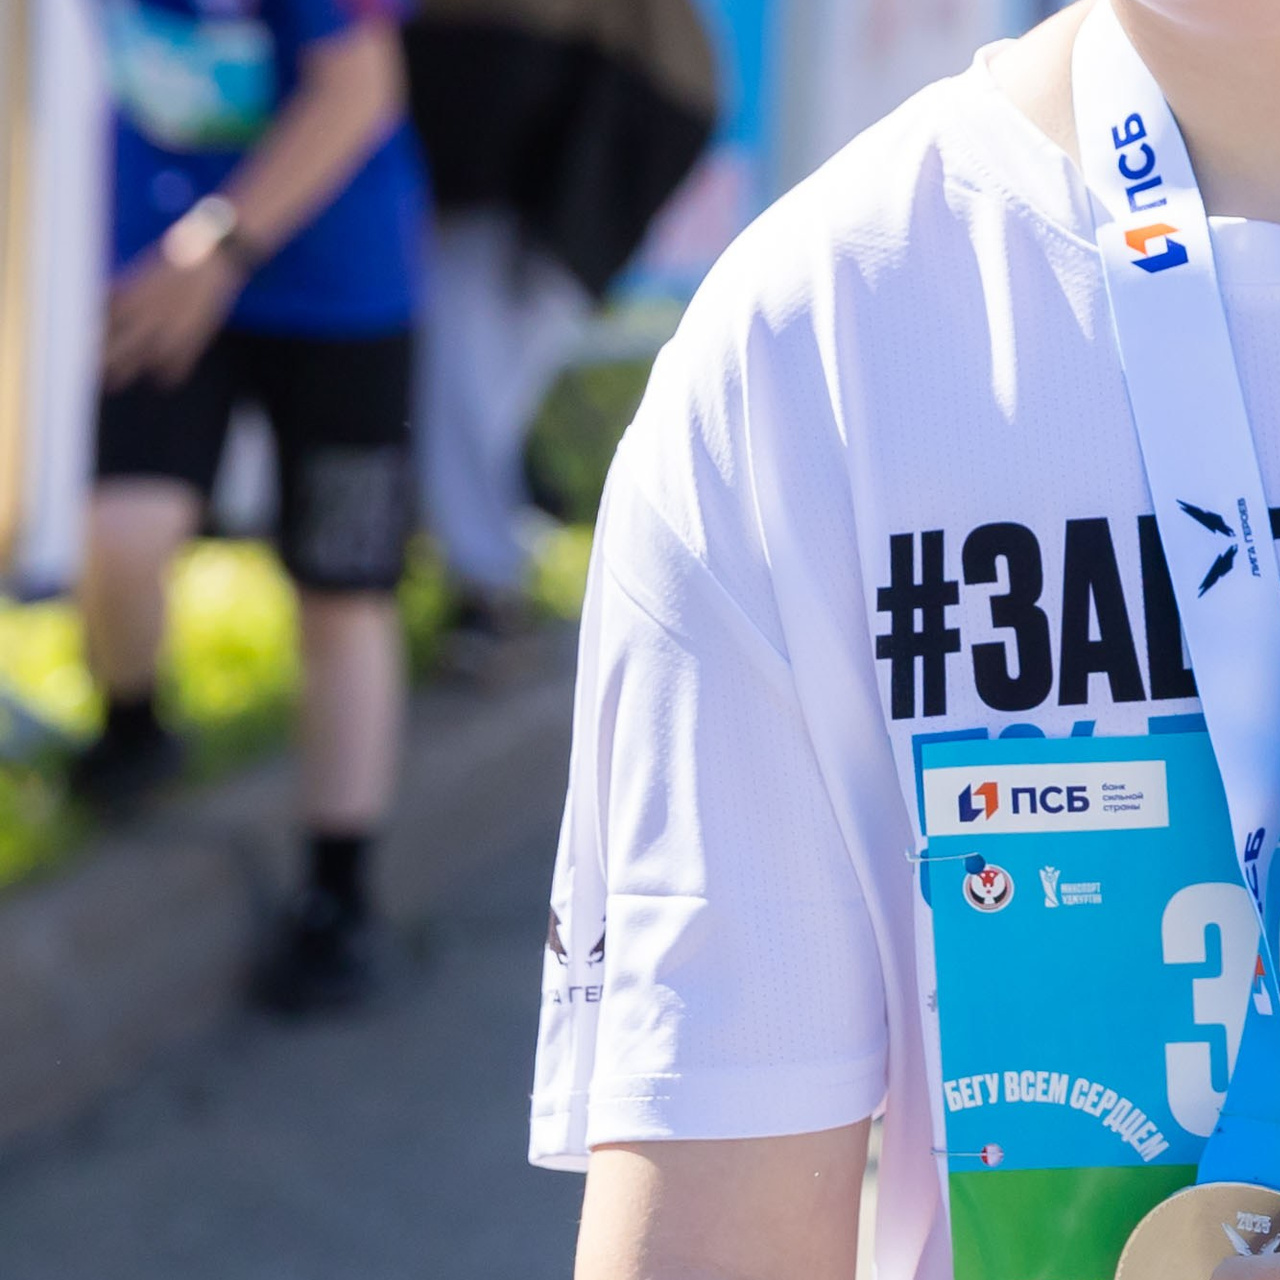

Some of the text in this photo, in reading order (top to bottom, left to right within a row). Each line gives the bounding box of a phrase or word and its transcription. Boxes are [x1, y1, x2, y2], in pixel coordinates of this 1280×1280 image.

[1111, 112, 1168, 213] ПСБ
[1101, 782, 1126, 791] банк
[1102, 792, 1144, 801] сильной
[1010, 785, 1090, 815] ПСБ
[1103, 803, 1141, 812] страны
[943, 1070, 1170, 1163] БЕГУ ВСЕМ СЕРДЦЕМ
[1235, 1211, 1272, 1235] 2025
